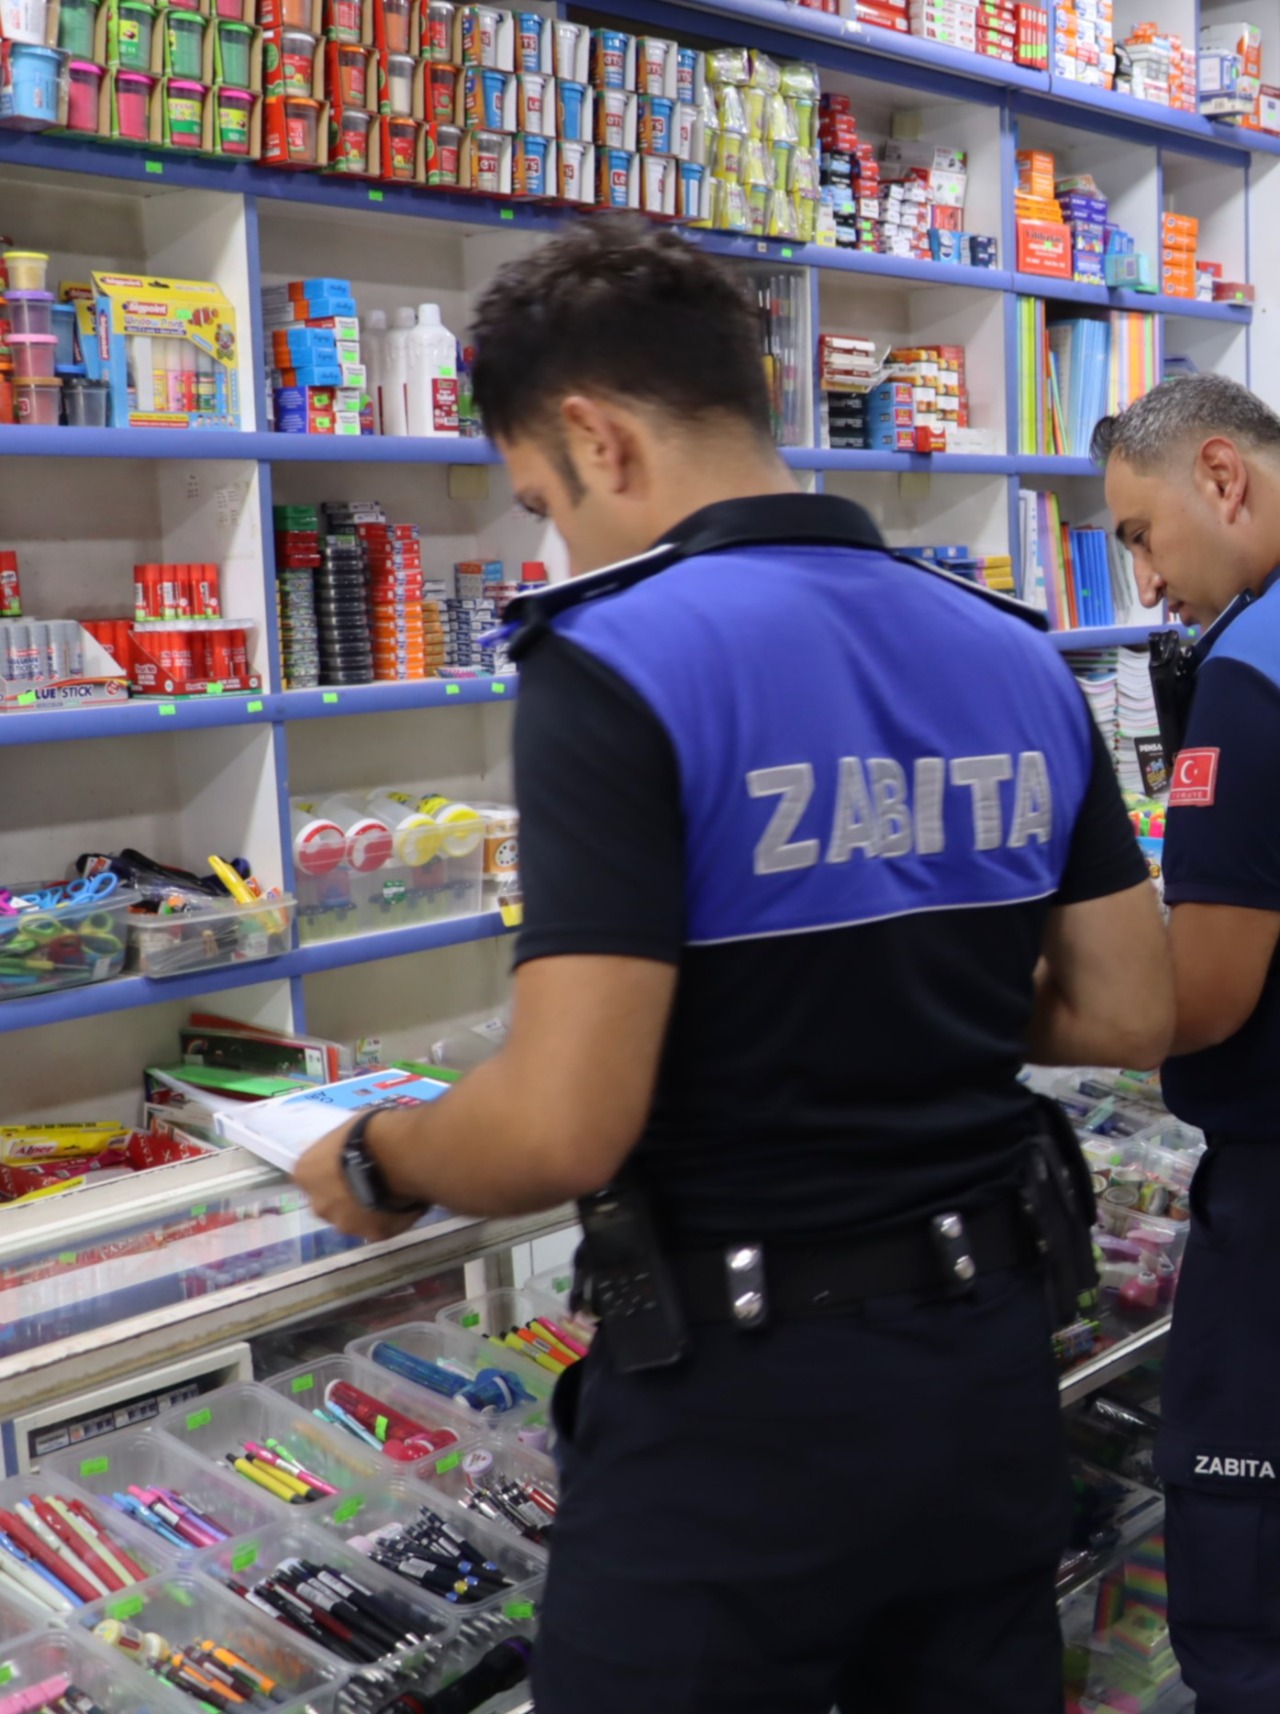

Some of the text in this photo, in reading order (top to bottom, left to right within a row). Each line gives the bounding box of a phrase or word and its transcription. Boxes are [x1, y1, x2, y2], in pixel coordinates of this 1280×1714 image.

[62, 684, 93, 698] STICK
[746, 751, 1052, 876] ZABITA
[1194, 1454, 1276, 1479] ZABITA
